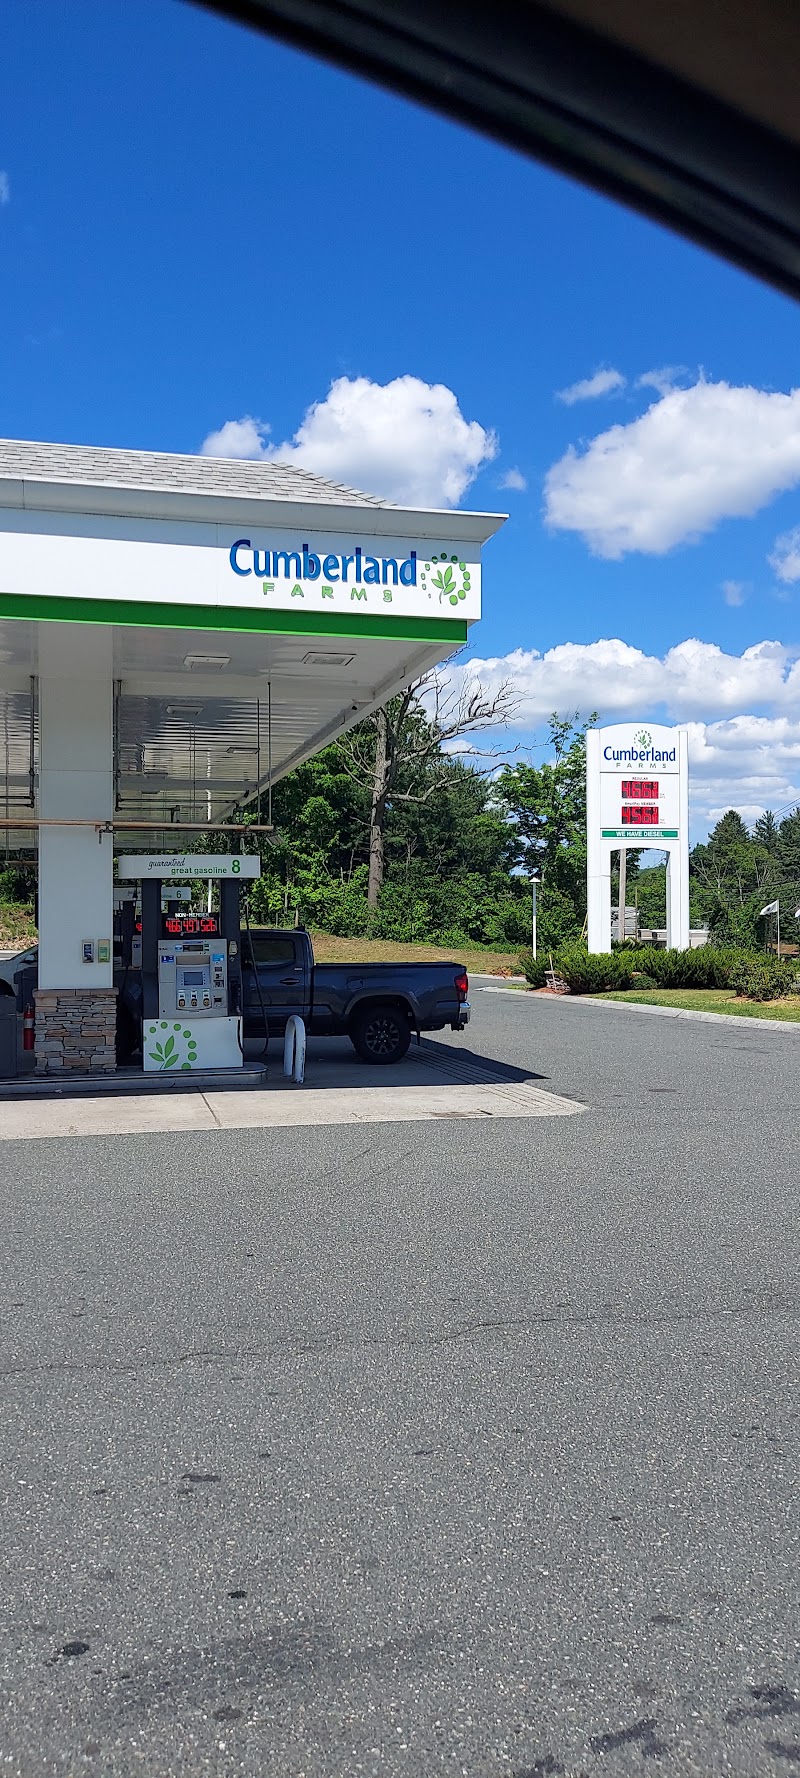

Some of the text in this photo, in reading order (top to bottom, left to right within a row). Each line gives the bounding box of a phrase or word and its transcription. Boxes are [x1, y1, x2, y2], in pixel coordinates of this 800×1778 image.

[229, 538, 417, 587] Cumberland
[262, 581, 393, 603] FARMS
[604, 746, 676, 762] Cumberland
[148, 857, 186, 871] guaranteed
[170, 866, 227, 875] great gasoline
[231, 859, 241, 874] 8
[176, 890, 182, 899] 6
